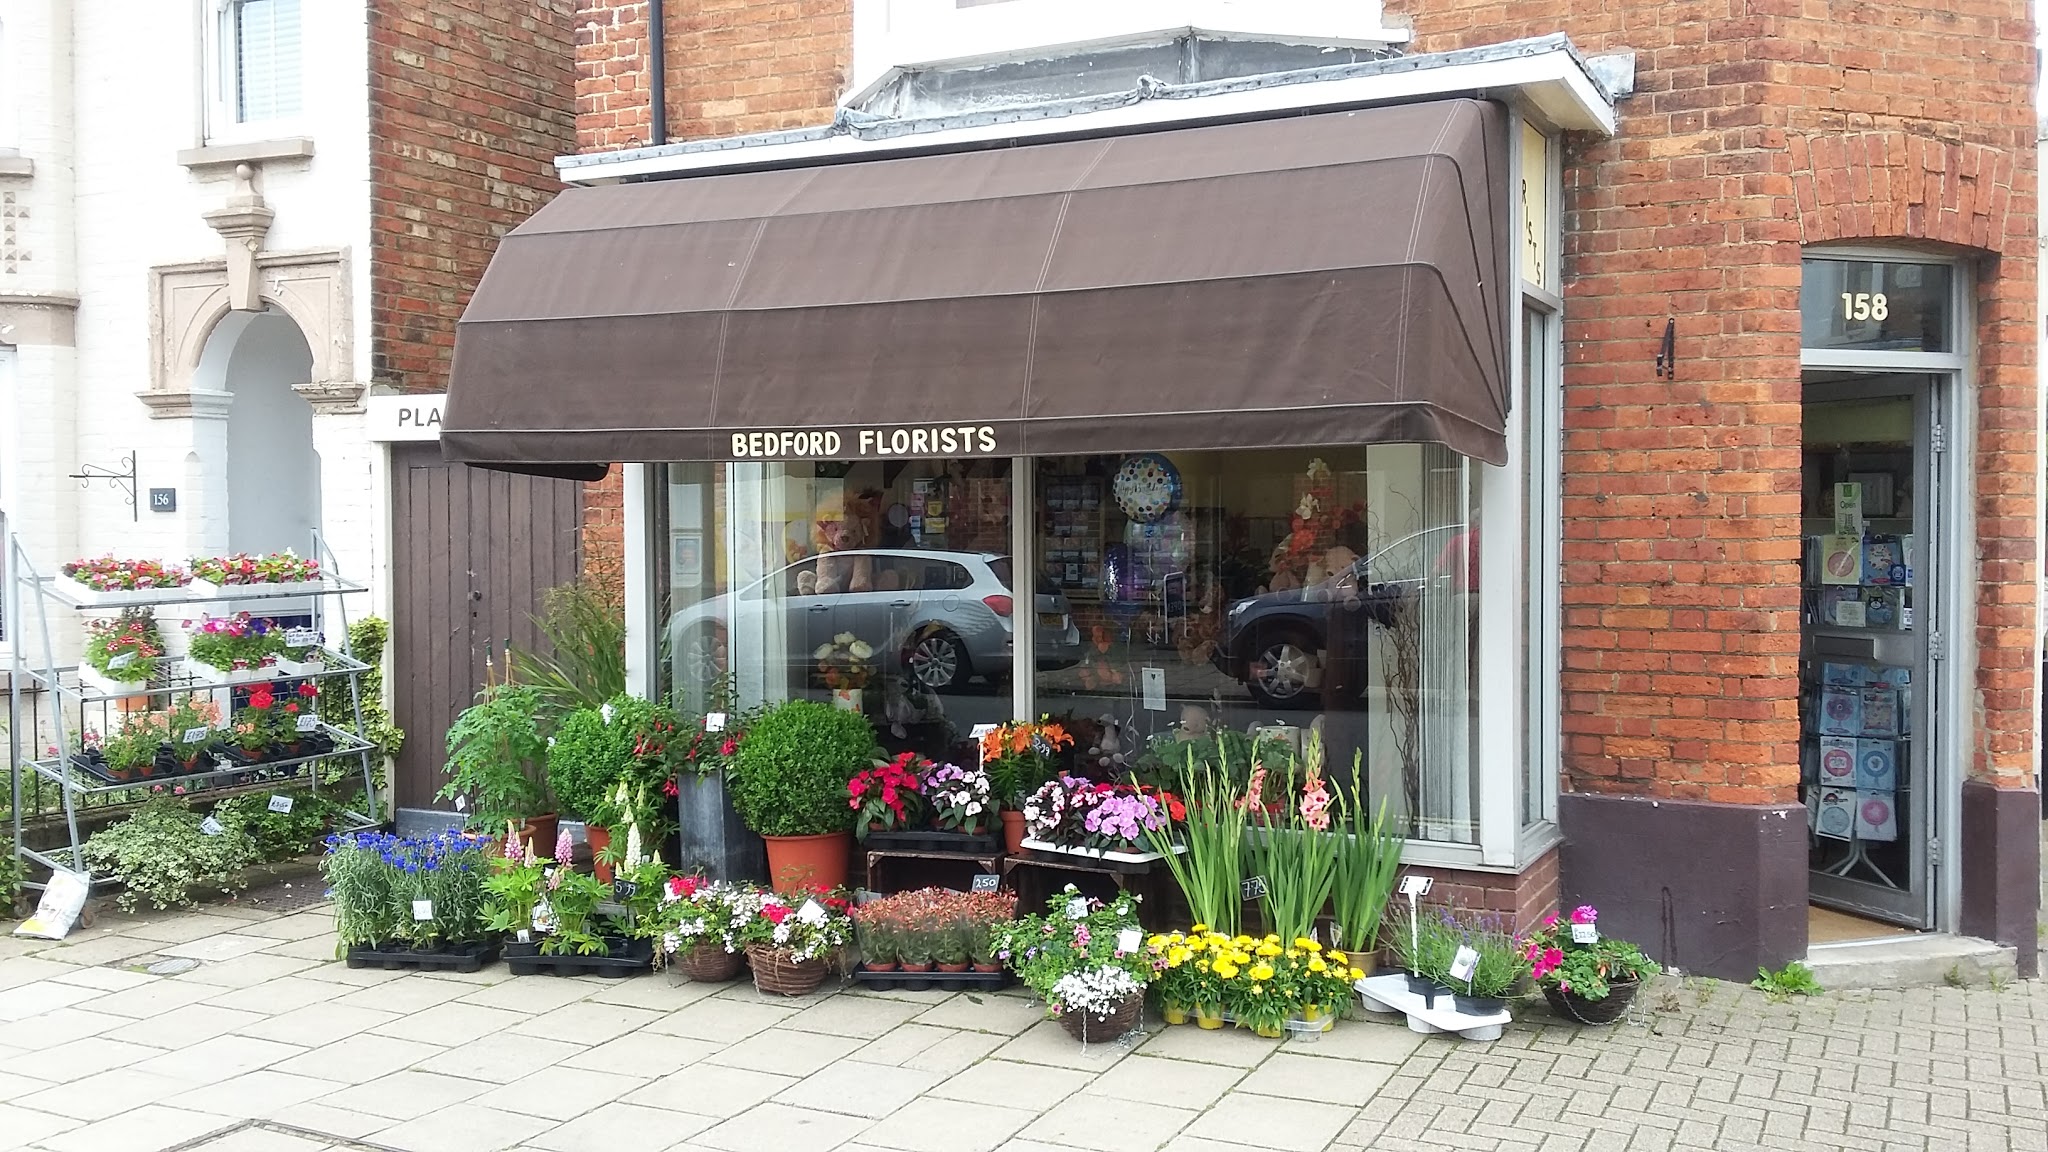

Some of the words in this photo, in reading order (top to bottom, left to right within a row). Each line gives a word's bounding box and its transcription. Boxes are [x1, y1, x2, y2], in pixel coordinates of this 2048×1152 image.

[1841, 293, 1889, 321] 158
[731, 431, 841, 457] BEDFORD
[859, 426, 997, 455] FLORISTS
[153, 493, 169, 506] 156
[1840, 501, 1856, 510] Open
[975, 878, 997, 889] 250
